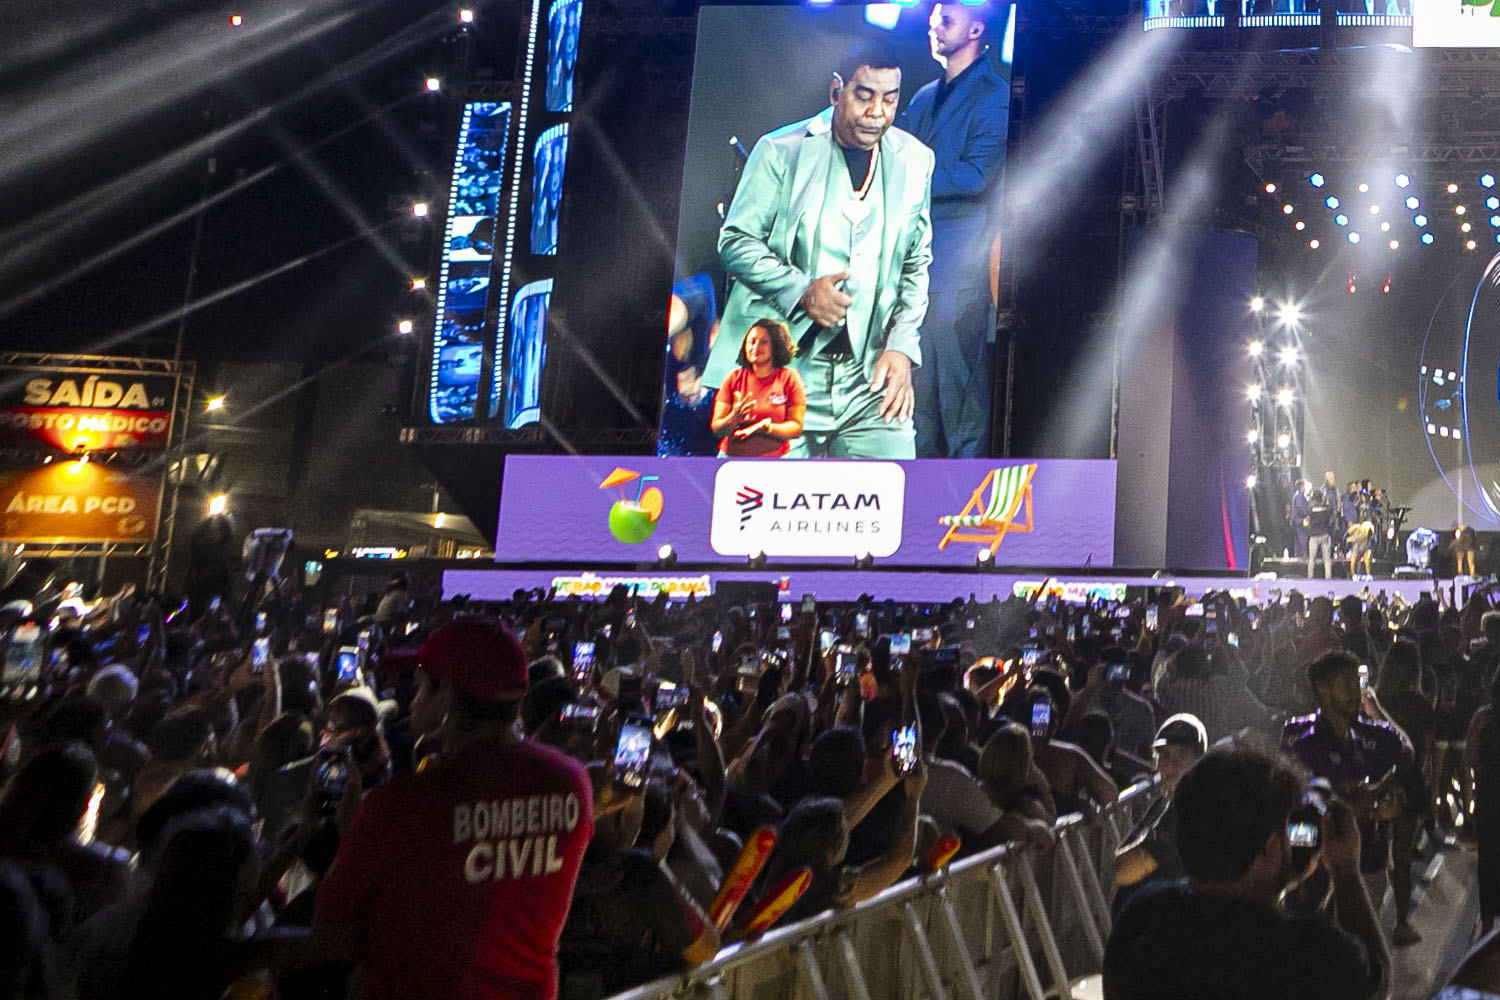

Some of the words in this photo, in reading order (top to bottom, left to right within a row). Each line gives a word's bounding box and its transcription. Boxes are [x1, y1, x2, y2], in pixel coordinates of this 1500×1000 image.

[23, 374, 150, 408] SAÍDA
[77, 410, 168, 433] MÉDICO
[6, 490, 78, 514] ÁREA
[84, 496, 136, 514] PCD
[773, 493, 881, 511] LATAM
[770, 520, 881, 533] AIRLINES
[453, 792, 580, 844] BOMBEIRO
[464, 834, 563, 883] CIVIL
